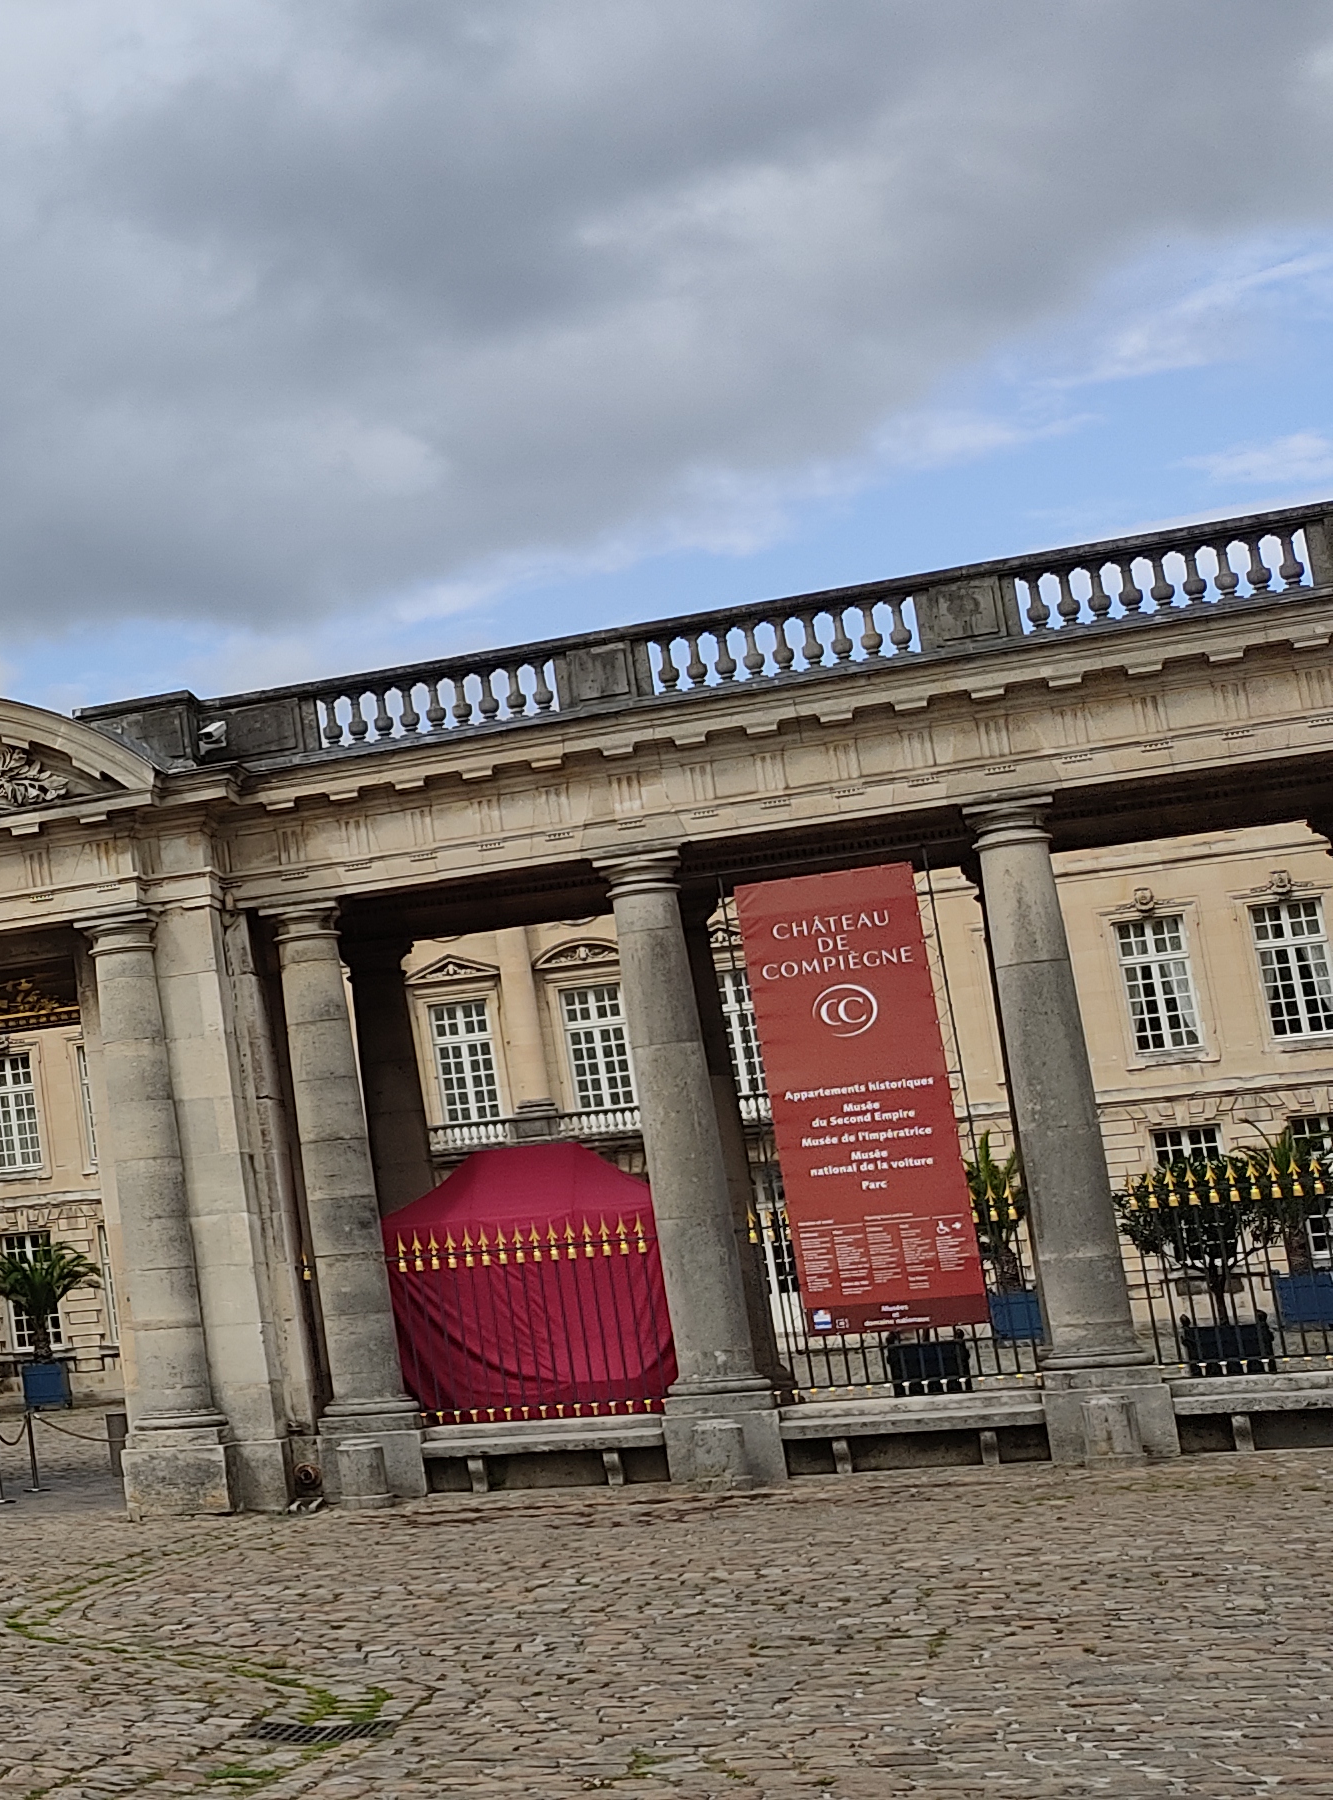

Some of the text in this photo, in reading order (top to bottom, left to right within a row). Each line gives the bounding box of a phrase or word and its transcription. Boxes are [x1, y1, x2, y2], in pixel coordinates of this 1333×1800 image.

[772, 909, 891, 941] CHÂTEAU
[817, 934, 850, 954] DE
[761, 945, 914, 981] COMPIÈGNE
[784, 1076, 935, 1102] Appartements historiques
[842, 1100, 881, 1113] Musée
[811, 1109, 916, 1129] du Second Empire
[801, 1133, 839, 1148] Musée
[841, 1131, 856, 1143] de
[850, 1149, 889, 1161] Musée
[809, 1156, 934, 1178] national de la voiture
[861, 1179, 888, 1191] Parc
